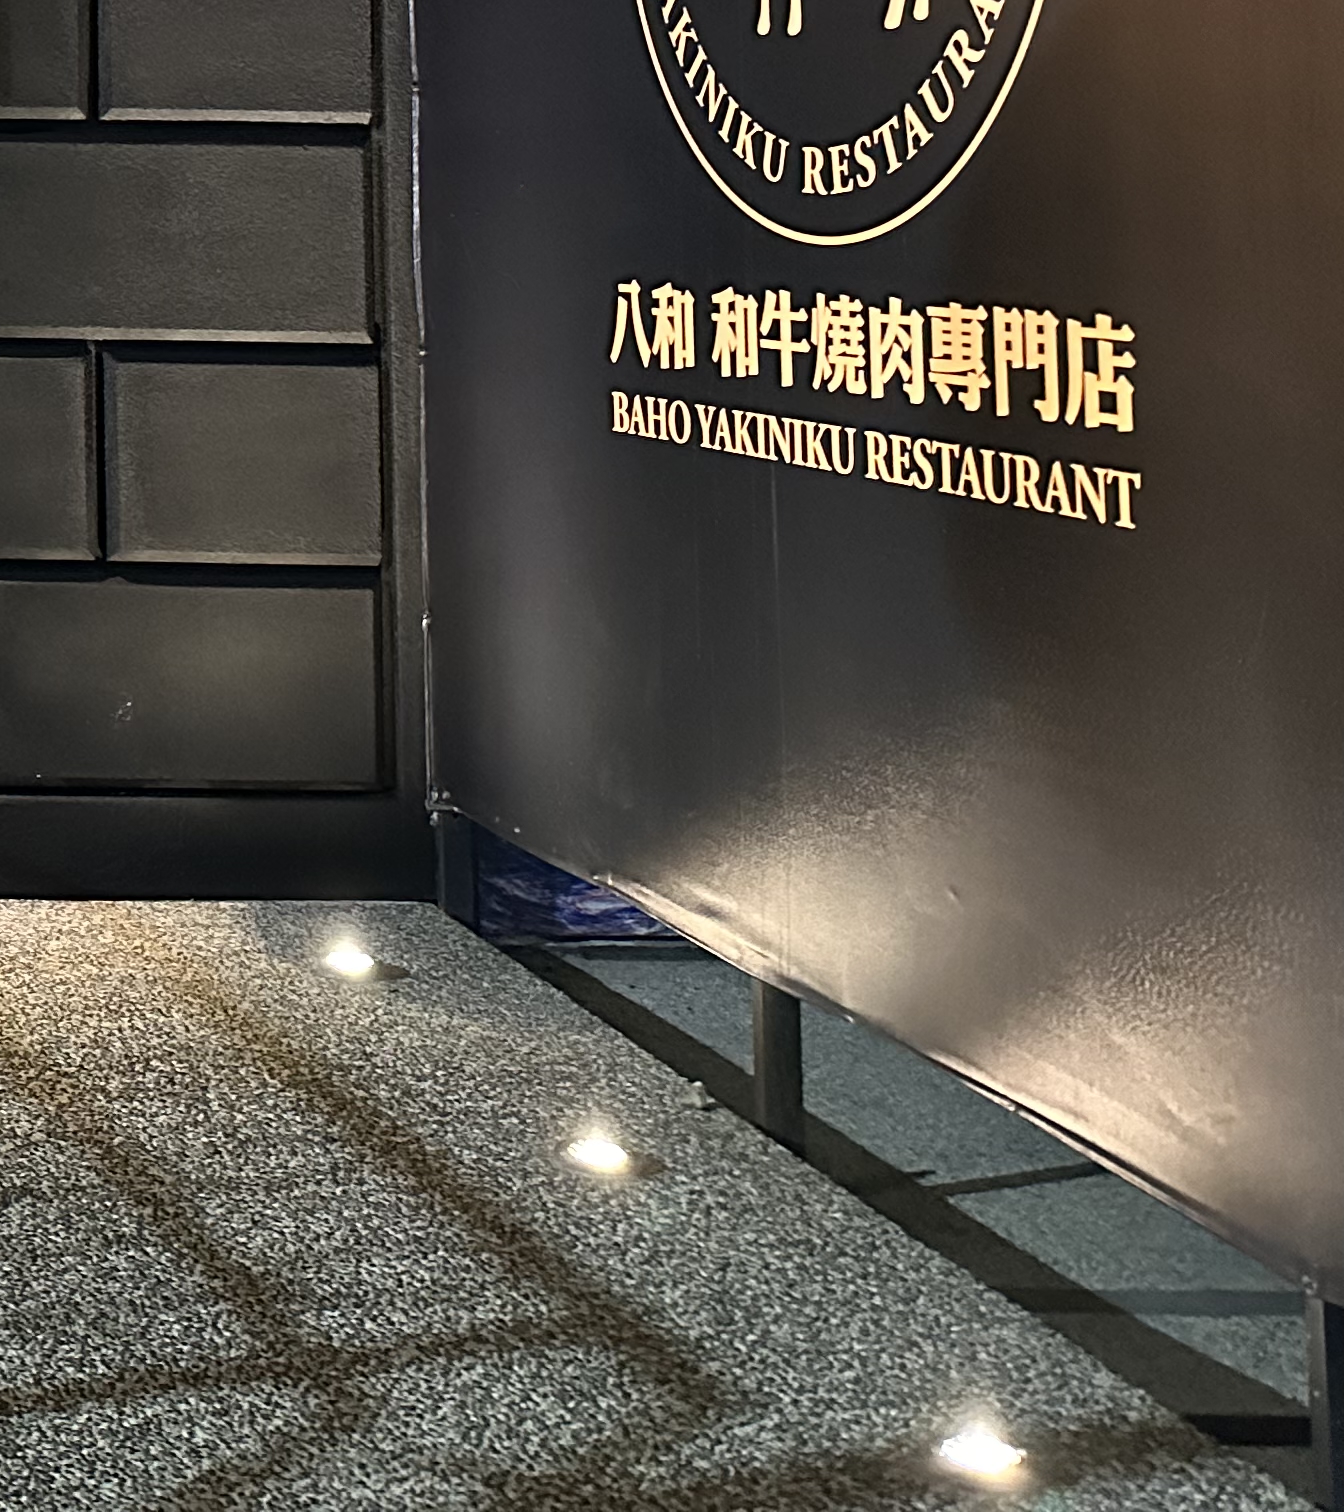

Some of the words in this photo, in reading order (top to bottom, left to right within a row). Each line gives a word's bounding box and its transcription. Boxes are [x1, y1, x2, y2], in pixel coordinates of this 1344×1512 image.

[608, 278, 696, 371] 八和
[710, 284, 1136, 434] 和牛燒肉專門店
[611, 390, 692, 445] BAHO
[697, 400, 858, 480] YAKINIKU
[864, 419, 1142, 530] RESTAURANT
